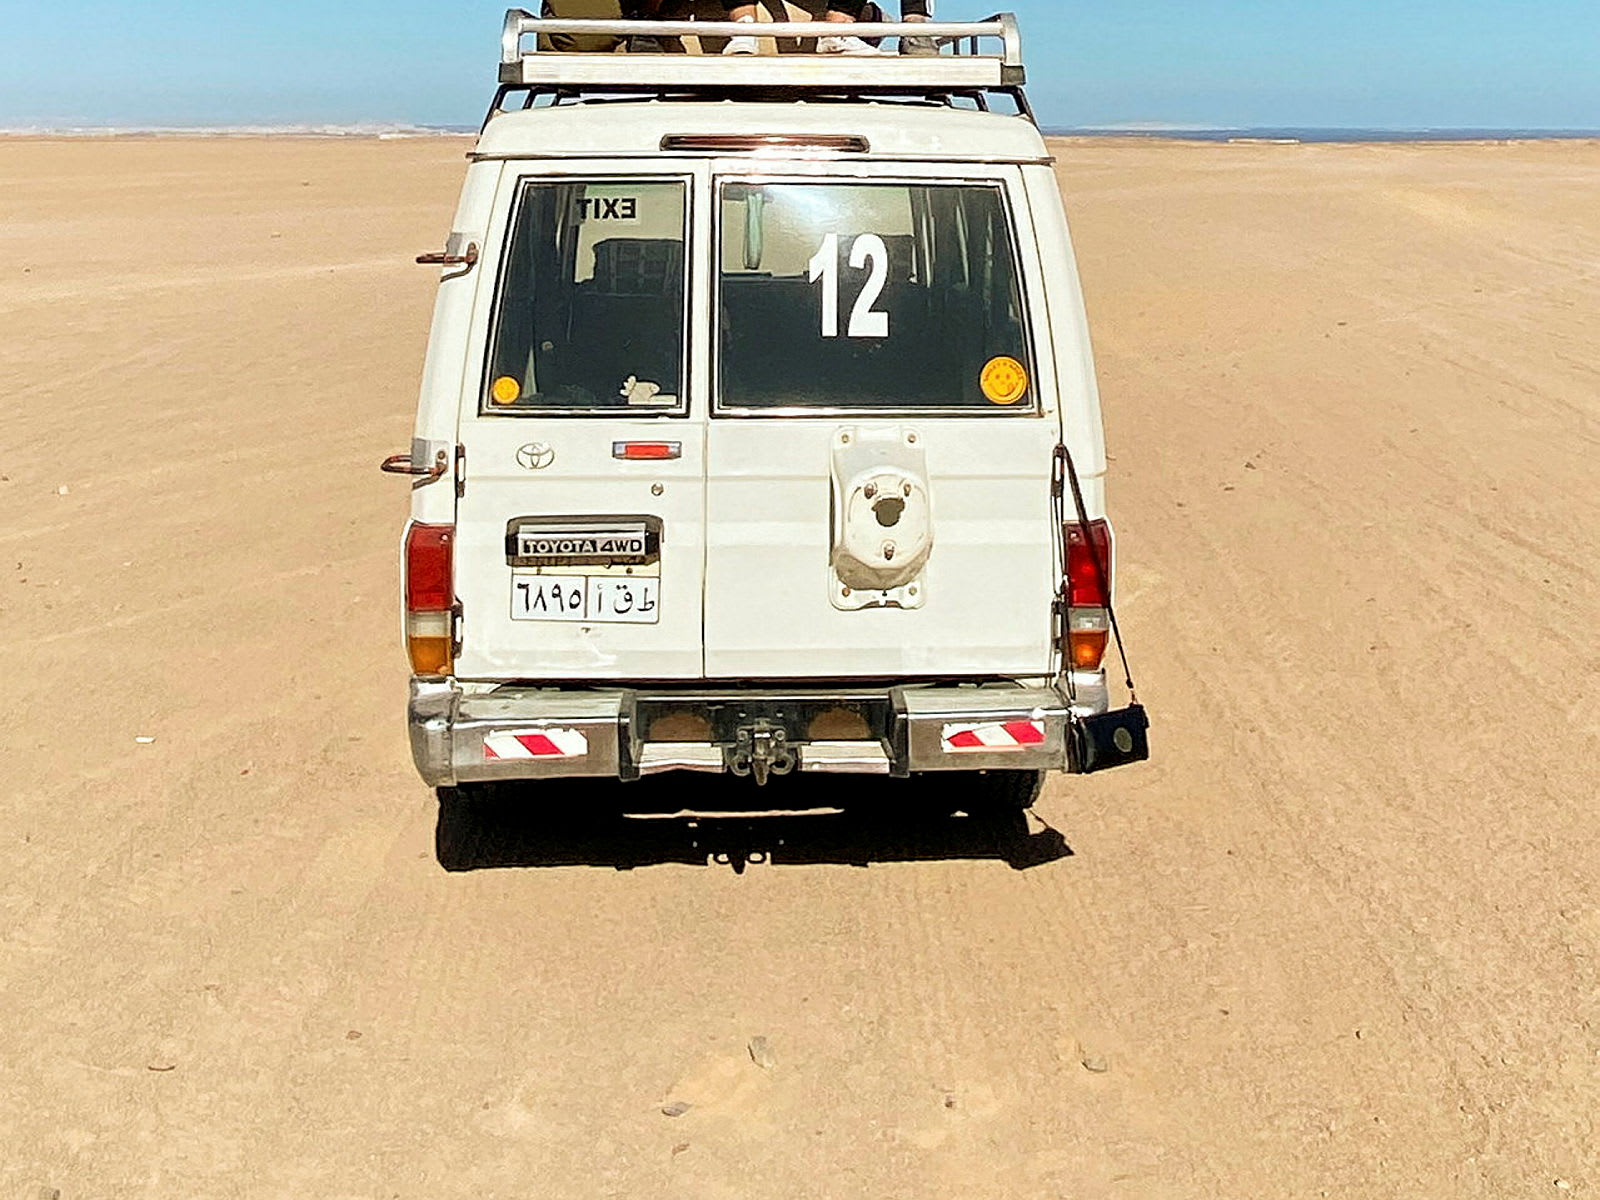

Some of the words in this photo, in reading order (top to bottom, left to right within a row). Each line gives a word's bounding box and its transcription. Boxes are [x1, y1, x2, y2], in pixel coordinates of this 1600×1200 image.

[808, 231, 889, 337] 12
[525, 539, 595, 553] TOYOTA
[600, 539, 643, 553] 4WD
[516, 583, 582, 613] ٦٨٩٥
